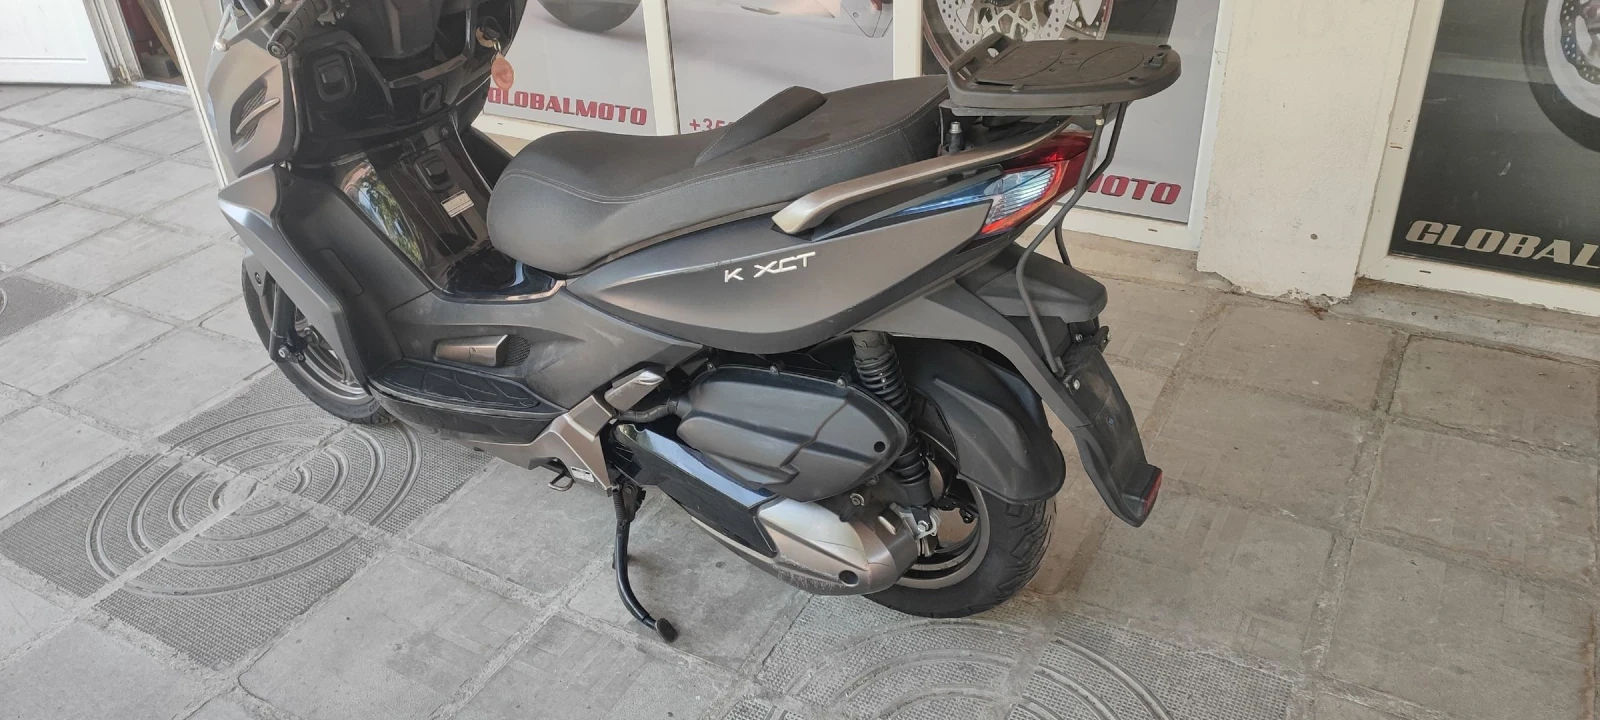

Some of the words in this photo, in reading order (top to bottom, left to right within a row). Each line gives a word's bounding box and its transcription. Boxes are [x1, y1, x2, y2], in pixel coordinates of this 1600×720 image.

[488, 87, 647, 126] GLOBALMOTO
[1405, 220, 1600, 269] GLOBAL
[724, 267, 744, 283] K
[753, 251, 816, 278] XCT
